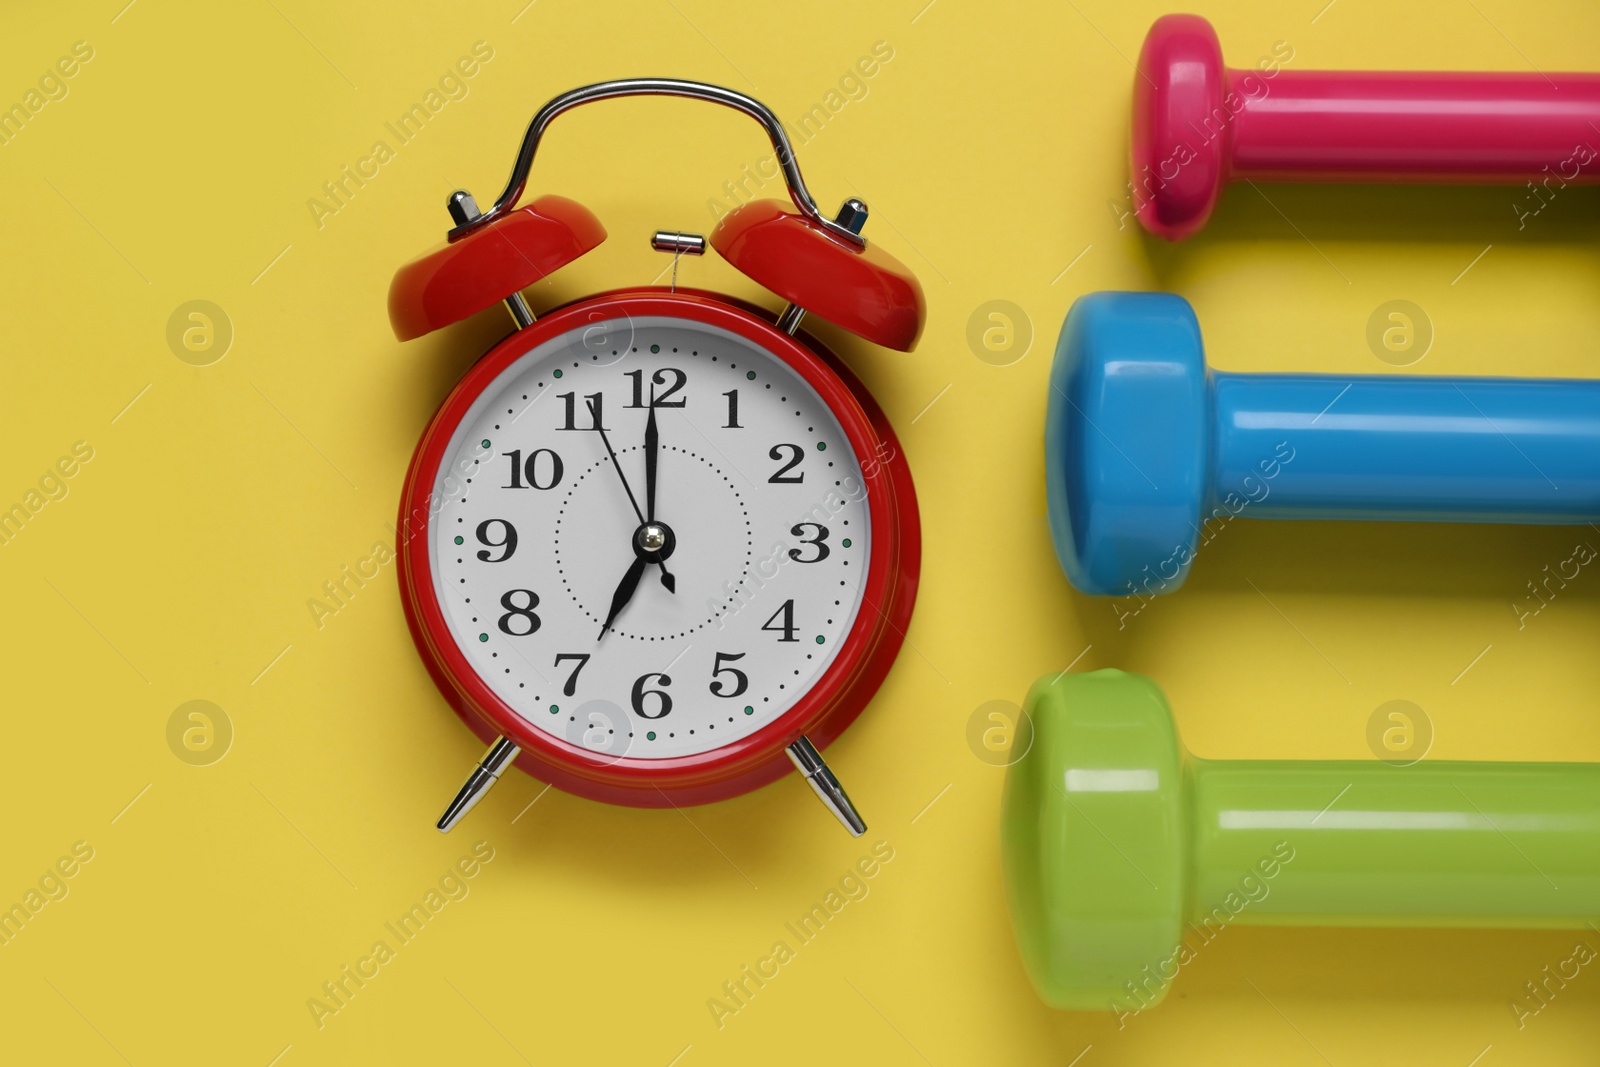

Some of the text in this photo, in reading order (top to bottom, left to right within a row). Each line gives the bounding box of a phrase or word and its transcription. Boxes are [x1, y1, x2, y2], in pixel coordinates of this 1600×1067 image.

[622, 367, 688, 409] 12
[555, 391, 612, 431] 11
[722, 390, 744, 428] 1
[501, 449, 563, 490] 10
[768, 444, 804, 483] 2
[476, 519, 517, 562] 9
[789, 523, 830, 563] 3
[498, 590, 541, 636] 8
[762, 600, 799, 641] 4
[555, 654, 590, 696] 7
[710, 652, 748, 697] 5
[632, 673, 672, 719] 6
